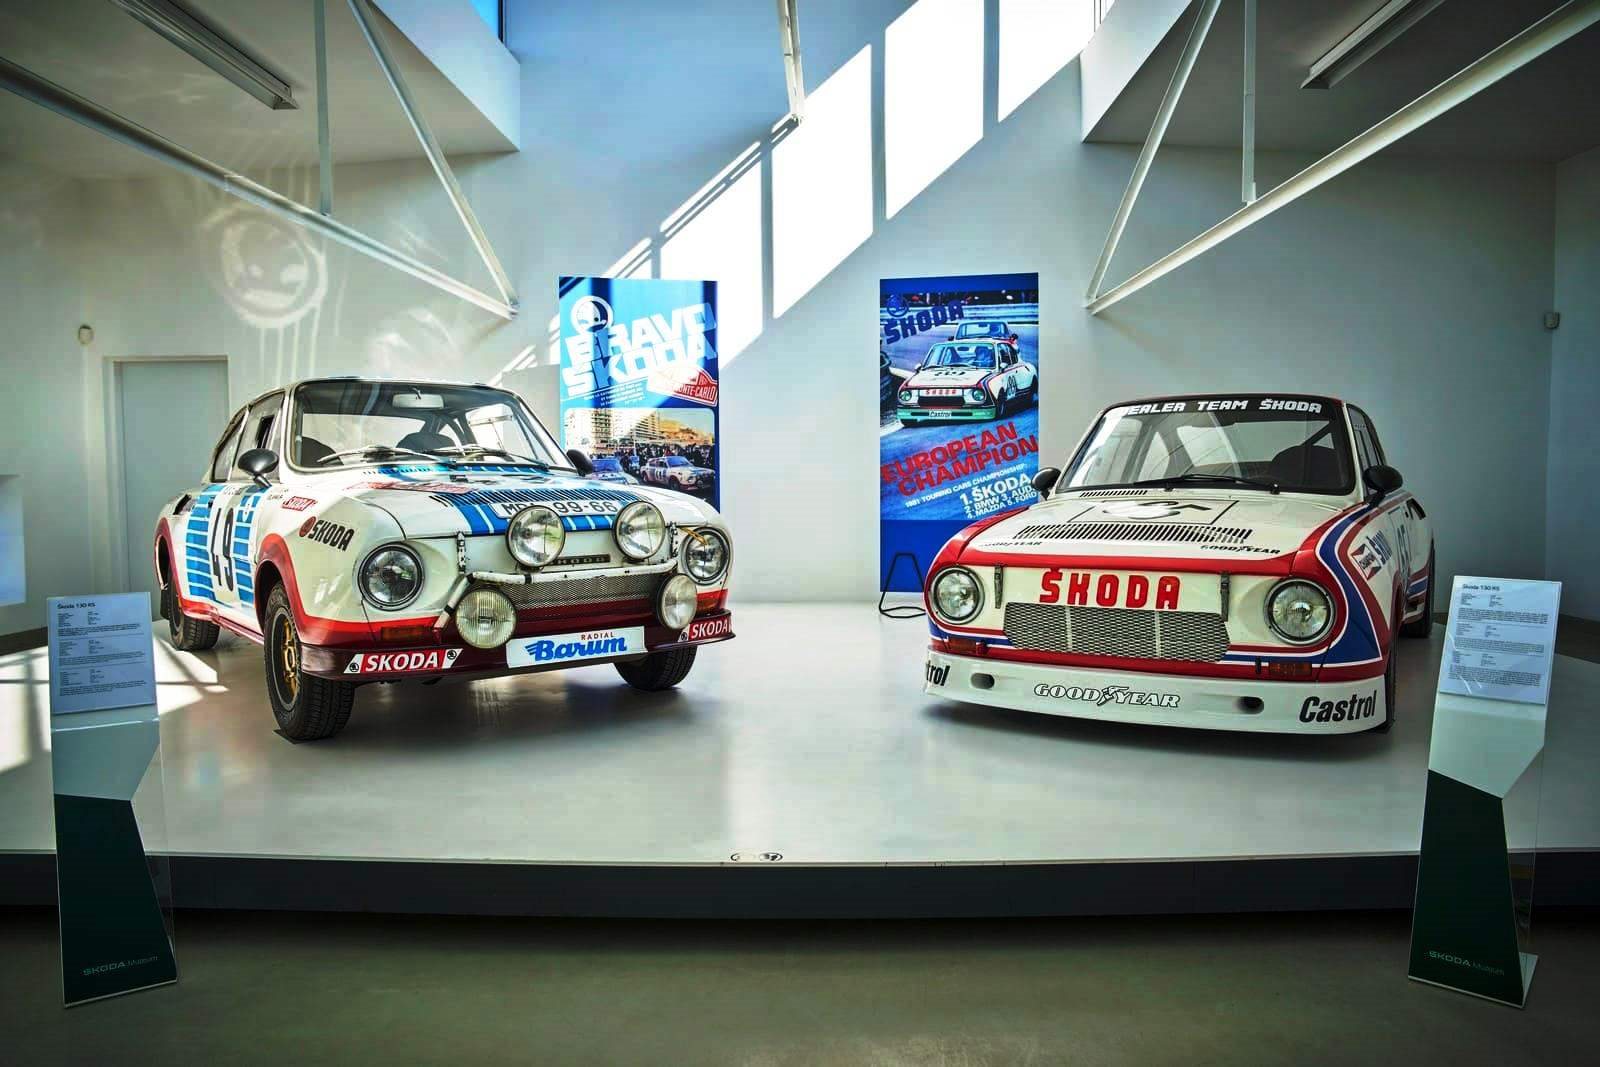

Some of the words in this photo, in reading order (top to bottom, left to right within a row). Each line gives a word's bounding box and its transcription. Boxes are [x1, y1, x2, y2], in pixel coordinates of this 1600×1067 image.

[1122, 402, 1185, 415] EALER
[1197, 400, 1249, 412] TEAM
[1259, 398, 1322, 414] ŠKODA
[880, 421, 1018, 483] EUROPEAN
[898, 435, 1039, 496] CHAMPION
[921, 488, 952, 502] TOURING
[952, 480, 972, 493] CARS
[959, 493, 973, 506] 1.
[971, 473, 1032, 502] ŠKODA
[974, 497, 1000, 510] BMW
[1011, 484, 1036, 498] AUD
[553, 501, 618, 514] 99-66
[975, 502, 1006, 518] MAZDA
[1014, 491, 1038, 505] FORD
[1200, 545, 1281, 555] GOODYEAR
[1038, 567, 1182, 611] ŠKODA
[580, 631, 615, 642] RADIAL
[691, 618, 729, 639] SKODA
[526, 636, 628, 662] Barum
[365, 652, 439, 673] SKODA
[1033, 684, 1181, 709] GOODYEAR
[1299, 690, 1378, 724] Castrol
